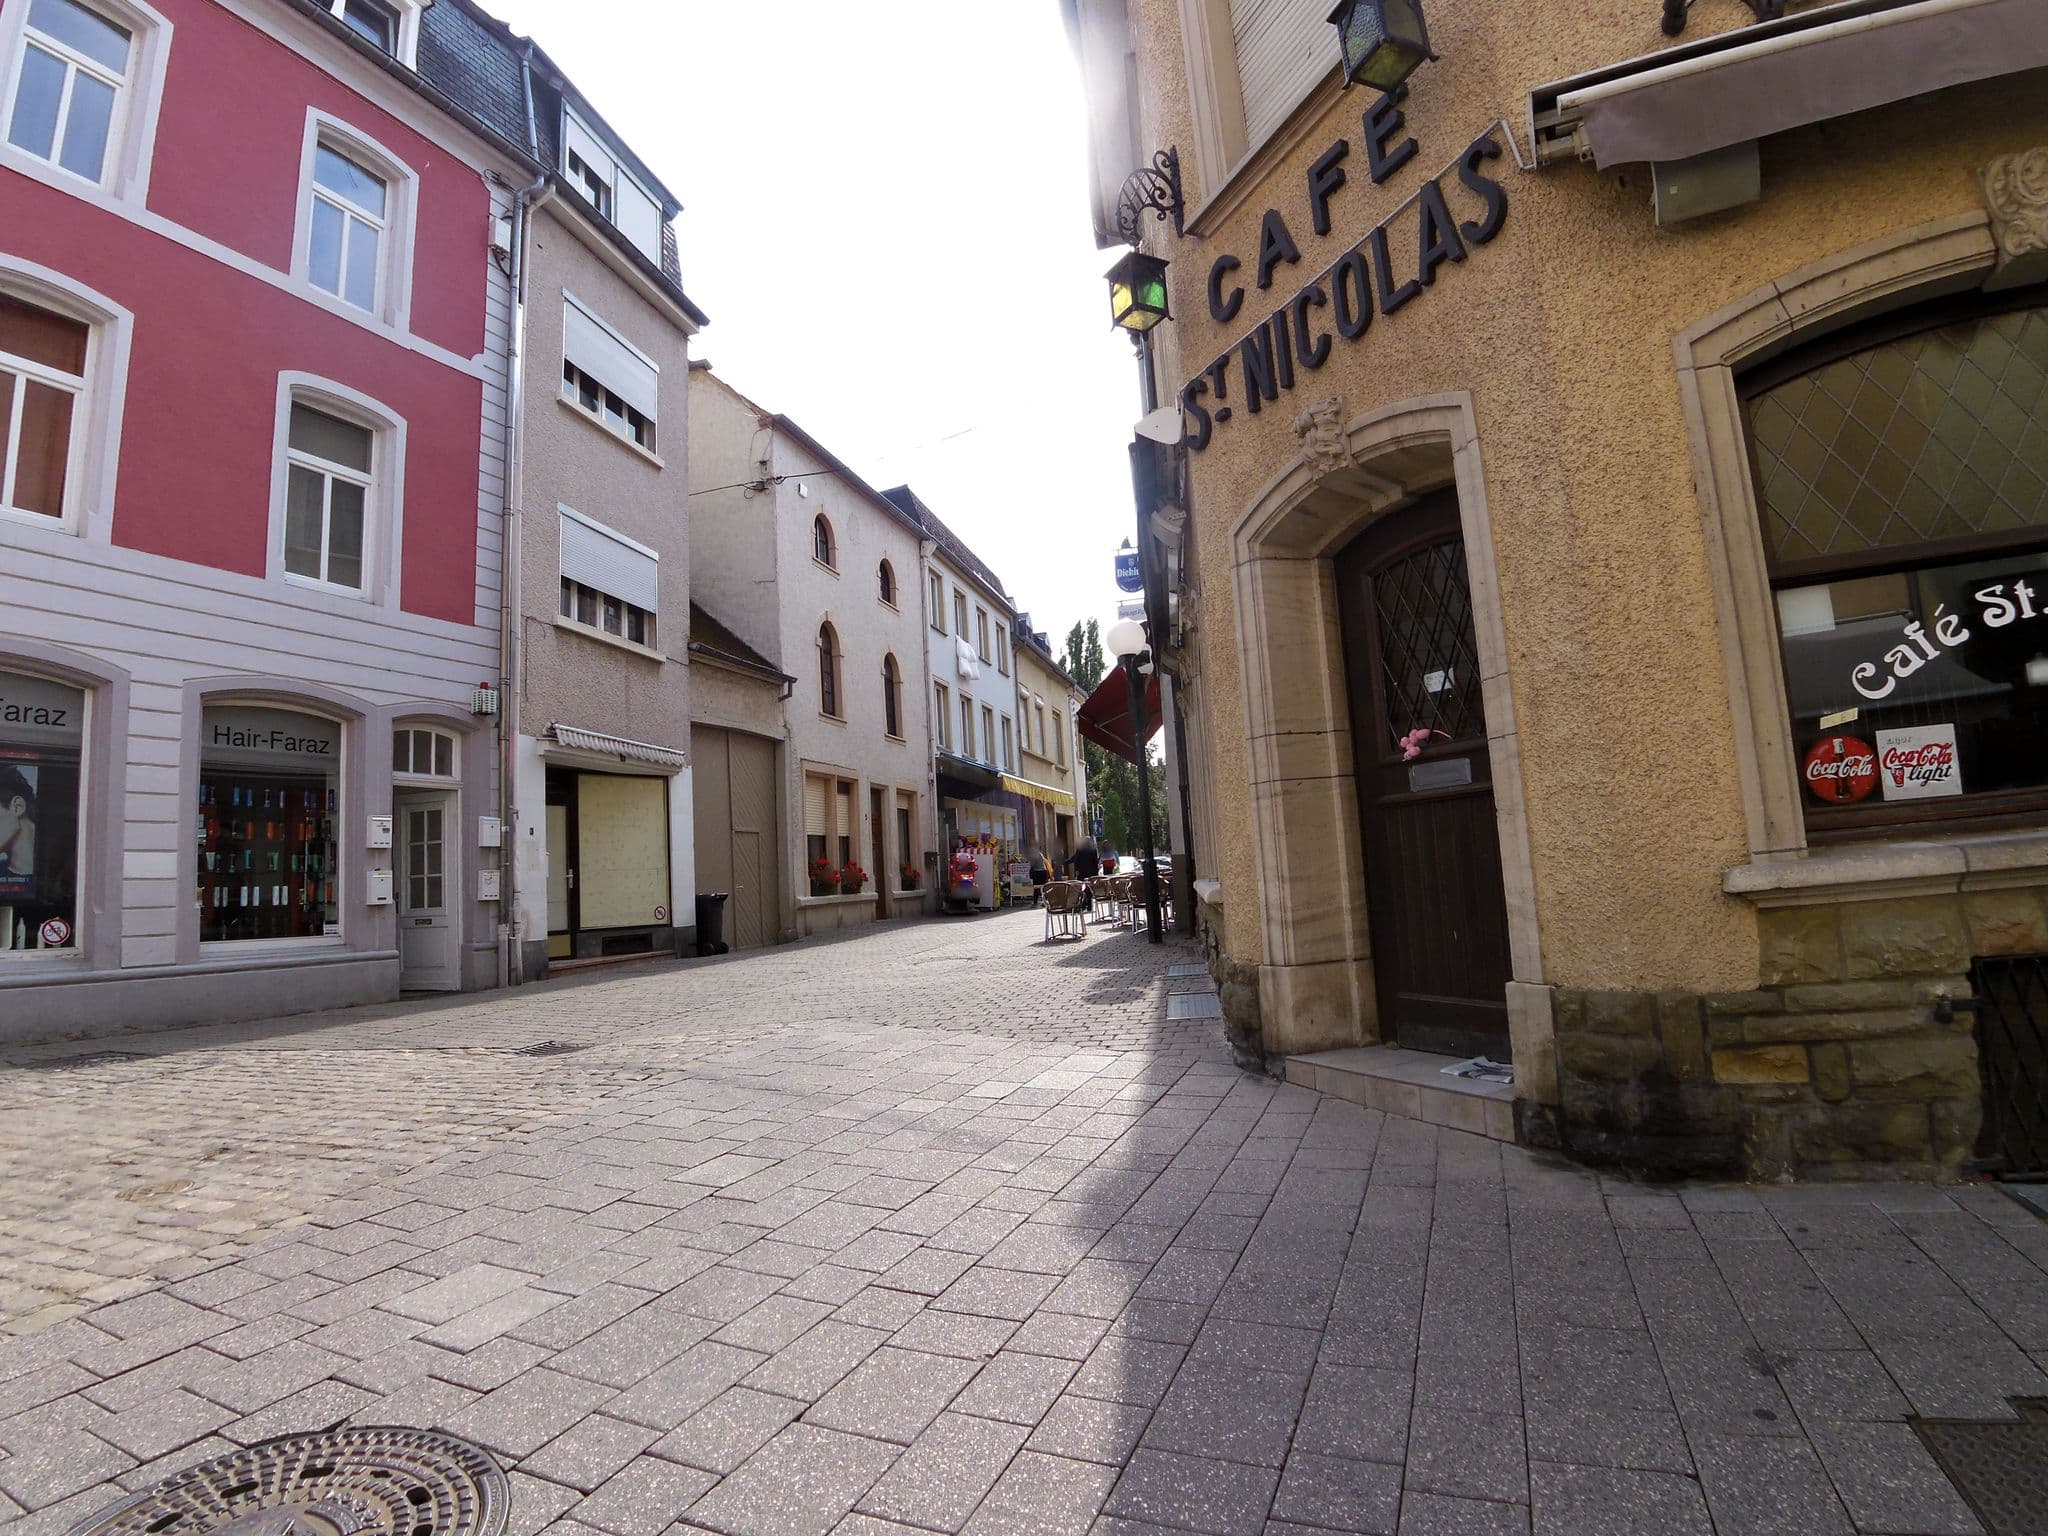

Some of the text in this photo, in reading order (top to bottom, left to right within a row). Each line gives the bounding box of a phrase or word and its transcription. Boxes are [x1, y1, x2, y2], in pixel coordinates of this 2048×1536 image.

[1241, 135, 1508, 414] NICOLAS
[1852, 603, 1970, 700] Café
[214, 725, 330, 755] Hair-Faraz
[1807, 754, 1874, 780] Coca-Cola
[1882, 742, 1953, 770] Coca-Cola
[1907, 763, 1953, 787] light
